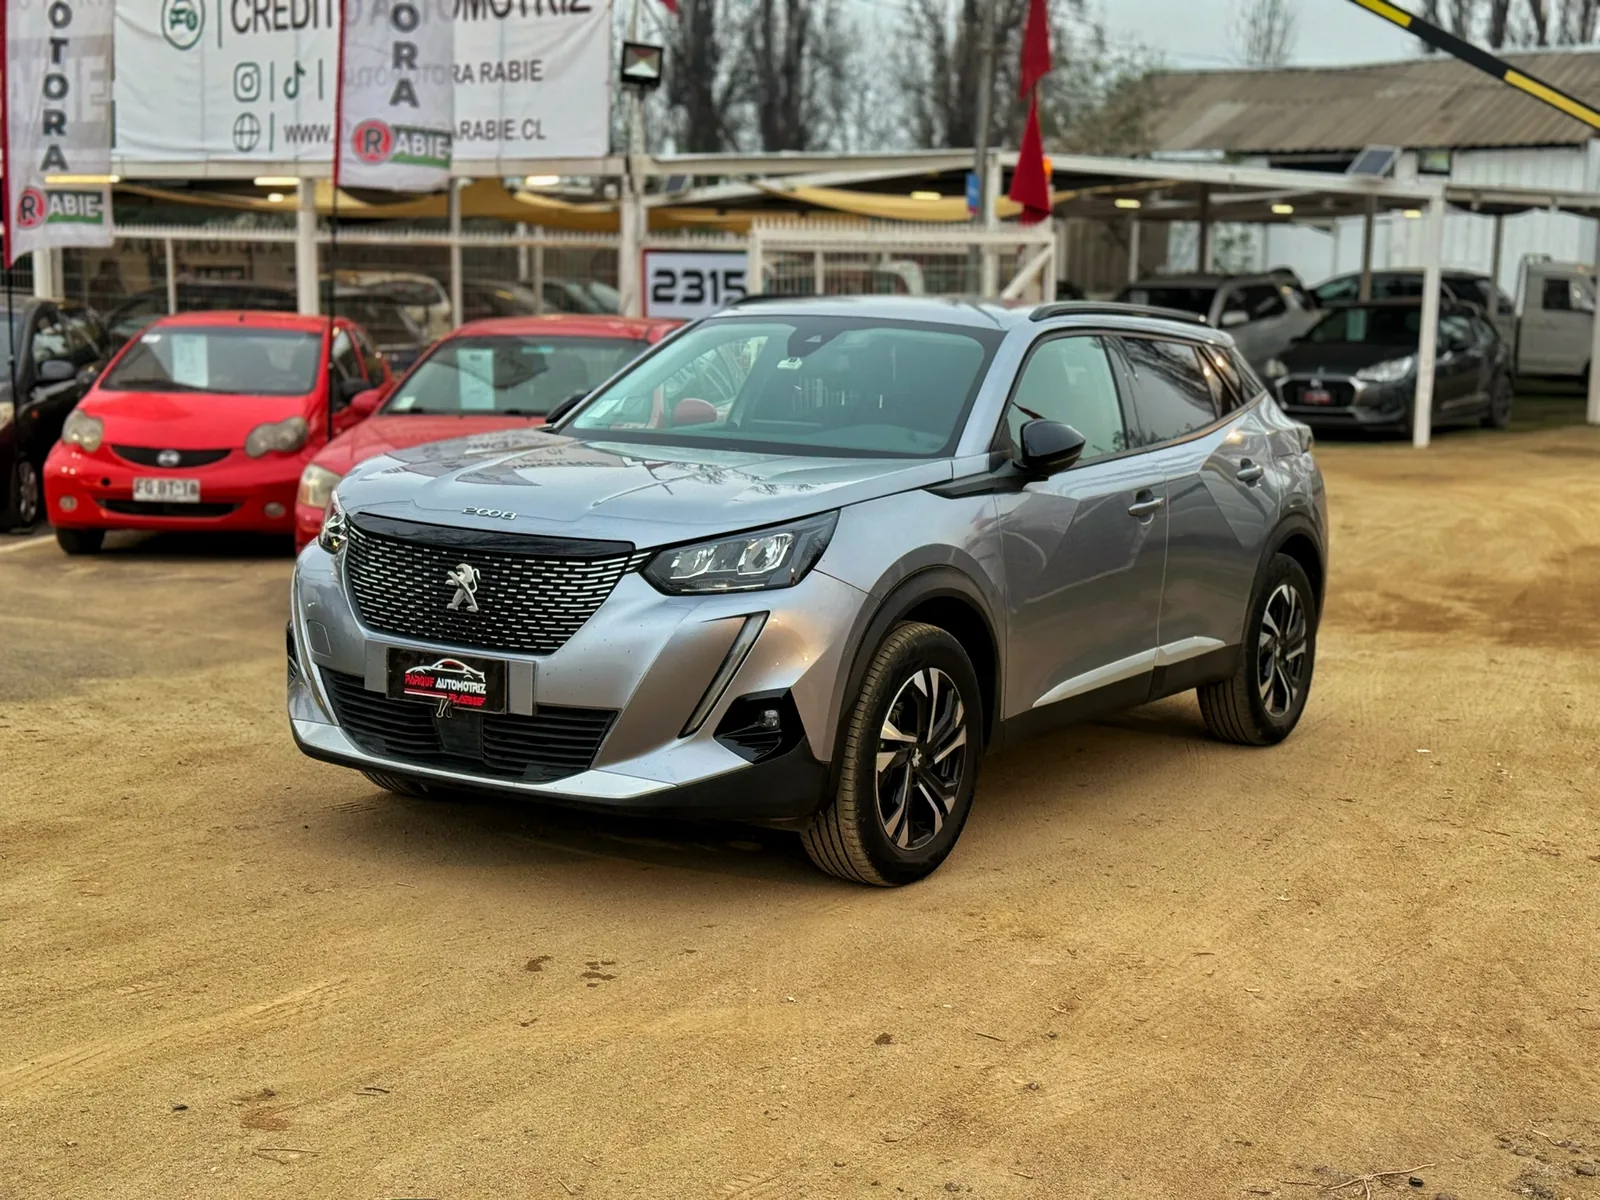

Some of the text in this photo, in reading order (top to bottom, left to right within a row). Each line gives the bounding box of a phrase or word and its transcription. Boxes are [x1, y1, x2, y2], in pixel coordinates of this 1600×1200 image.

[480, 59, 543, 83] RABIE
[652, 269, 747, 305] 2315
[462, 506, 517, 520] 2008
[435, 677, 487, 694] AUTOMOTRIZ
